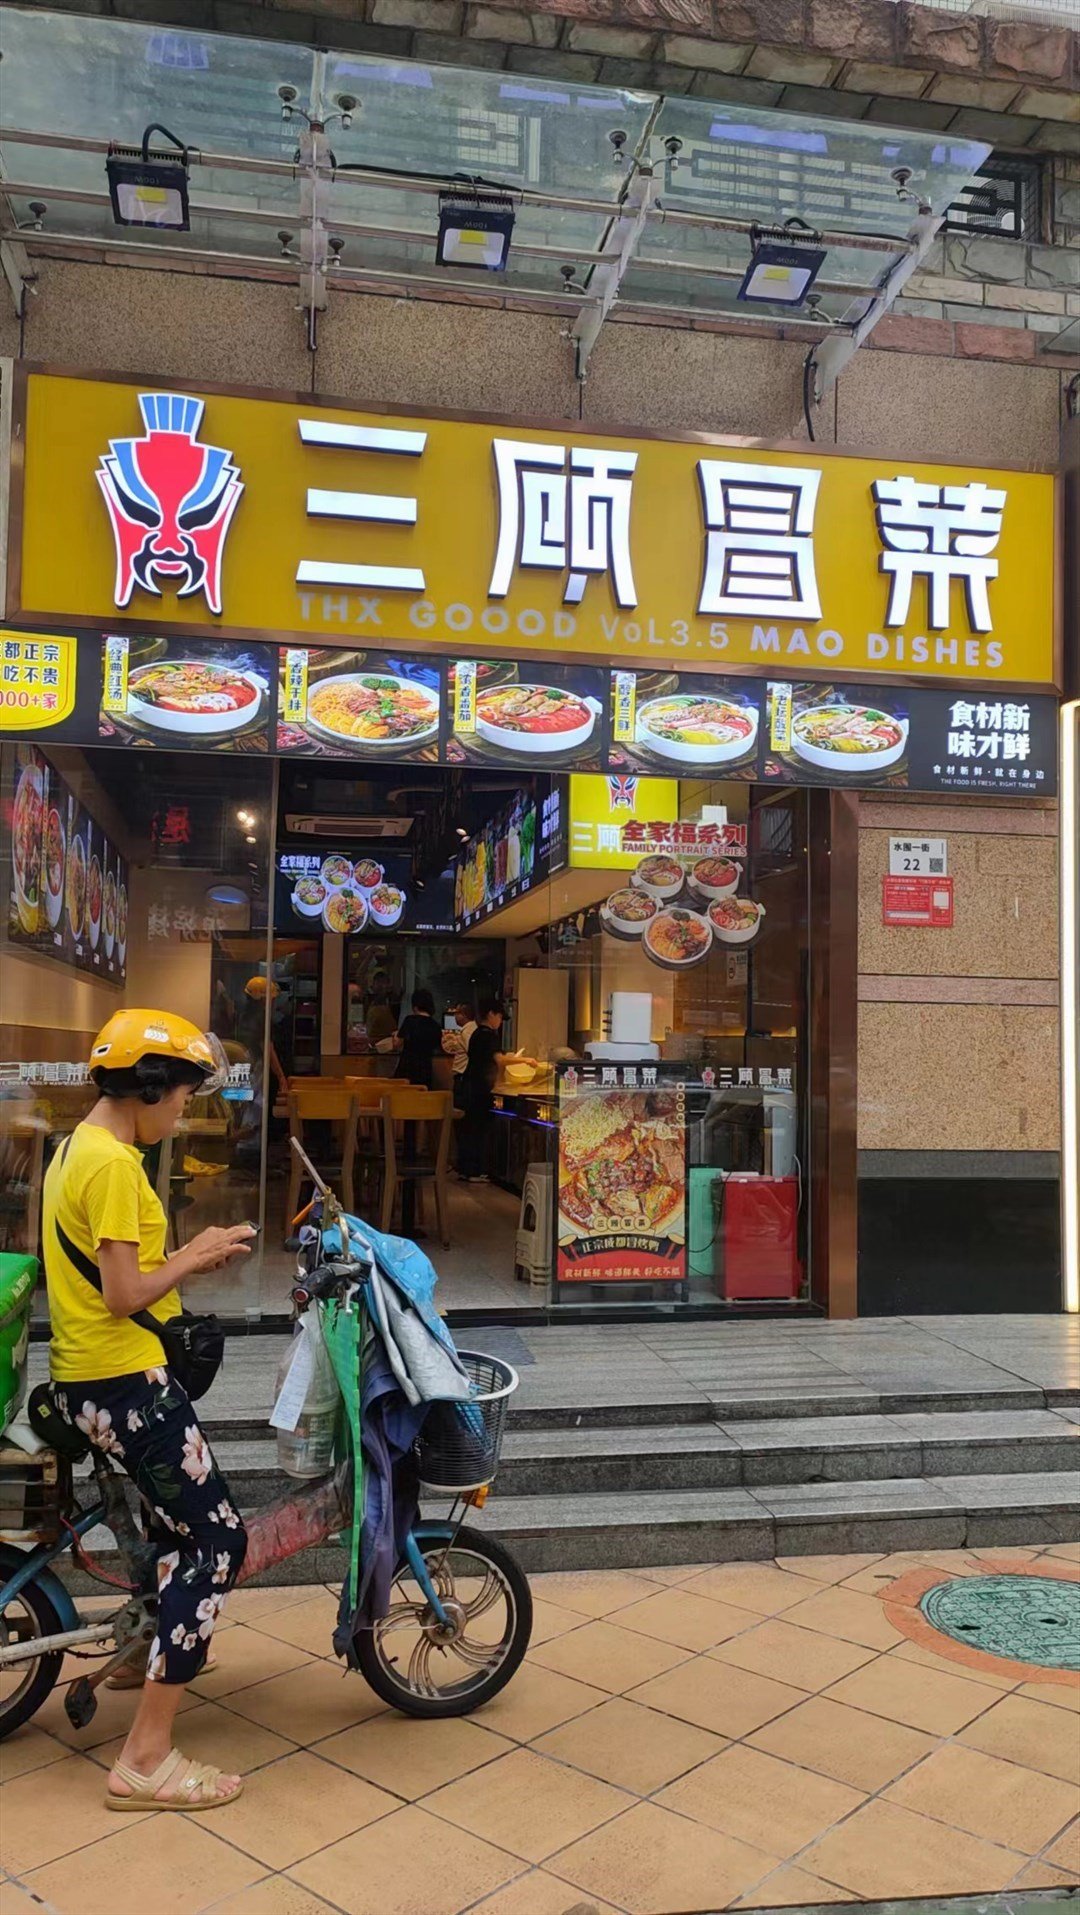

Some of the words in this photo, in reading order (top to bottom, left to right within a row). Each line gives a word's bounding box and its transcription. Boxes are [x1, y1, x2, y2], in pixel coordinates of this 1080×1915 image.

[296, 418, 1007, 632] 三顾冒菜
[300, 592, 383, 624] THX
[408, 600, 577, 638] GOOOD
[750, 624, 844, 657] MAO
[867, 633, 1004, 667] DISHES
[0, 641, 59, 661] 都正宗
[949, 700, 1031, 732] 食材新
[947, 732, 1031, 760] 味才鲜
[621, 819, 747, 846] 全家福系列
[622, 843, 656, 854] FAMILY
[659, 844, 709, 855] PORTRAIT
[712, 846, 746, 857] SERIES
[903, 858, 920, 871] 22
